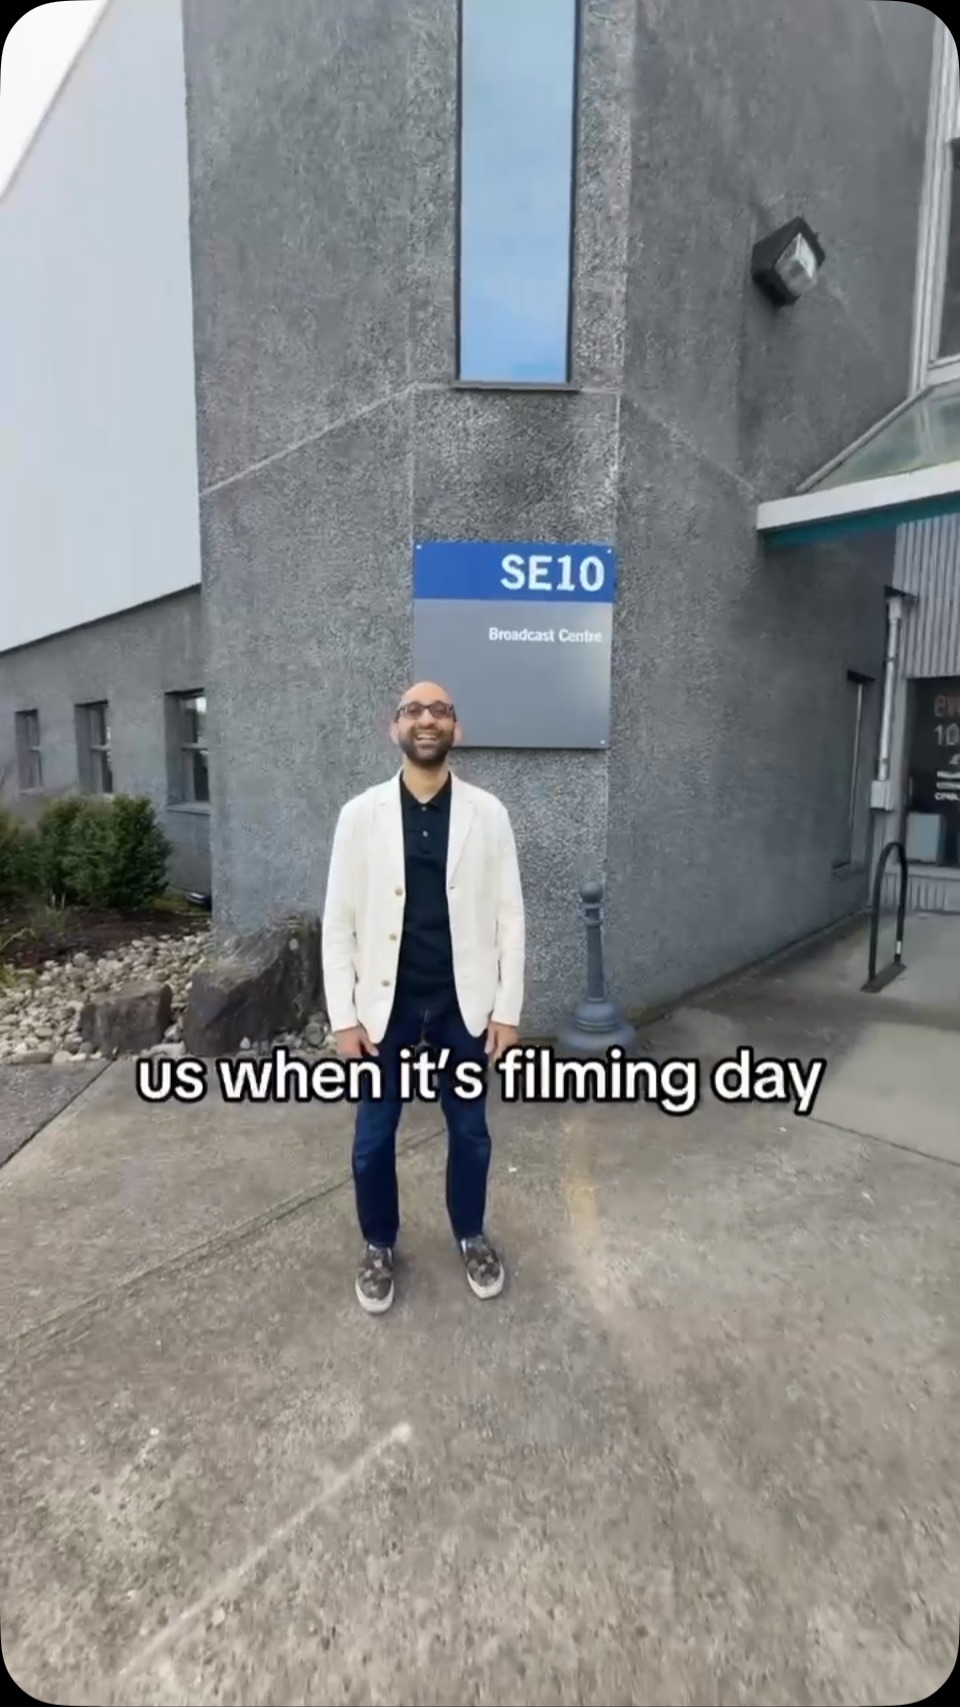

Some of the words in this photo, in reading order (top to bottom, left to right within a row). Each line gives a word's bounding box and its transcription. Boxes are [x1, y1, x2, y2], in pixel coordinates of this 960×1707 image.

[501, 554, 604, 592] SE10
[489, 627, 555, 642] Broadcast
[560, 629, 602, 643] Centre
